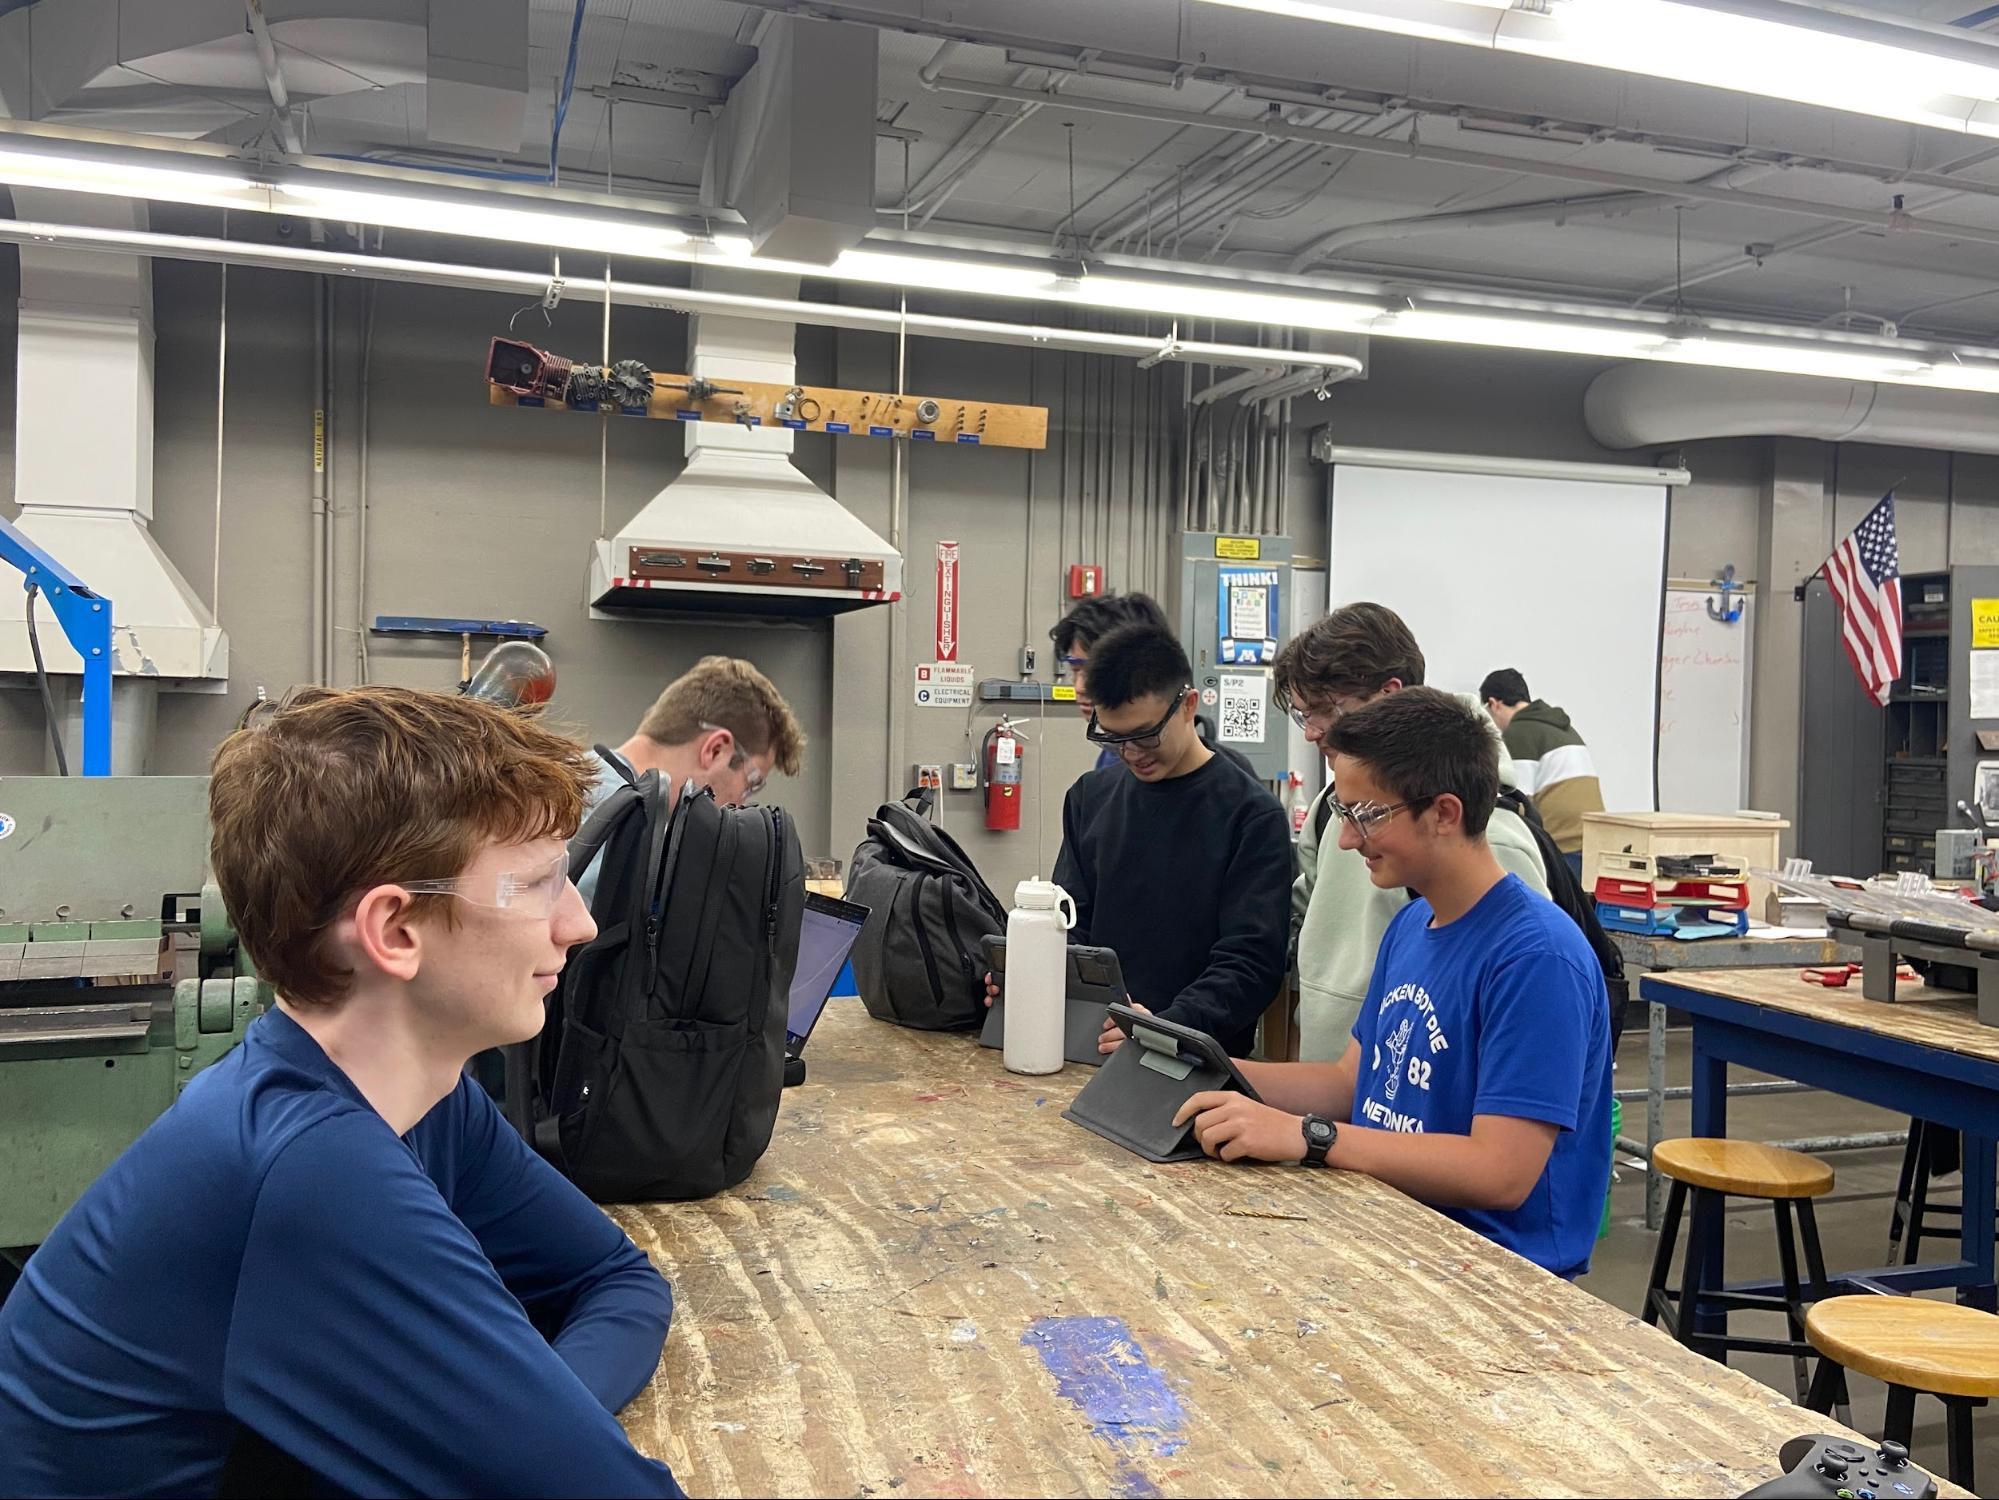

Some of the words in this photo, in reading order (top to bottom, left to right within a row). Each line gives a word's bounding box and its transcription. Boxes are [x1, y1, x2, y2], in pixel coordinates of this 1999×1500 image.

[940, 549, 958, 560] FIRE
[1220, 572, 1278, 587] THINK!
[943, 560, 952, 651] EXTINGUISHER
[1414, 986, 1435, 1018] BOT
[1425, 1014, 1449, 1054] PIE
[1408, 1056, 1431, 1090] 82
